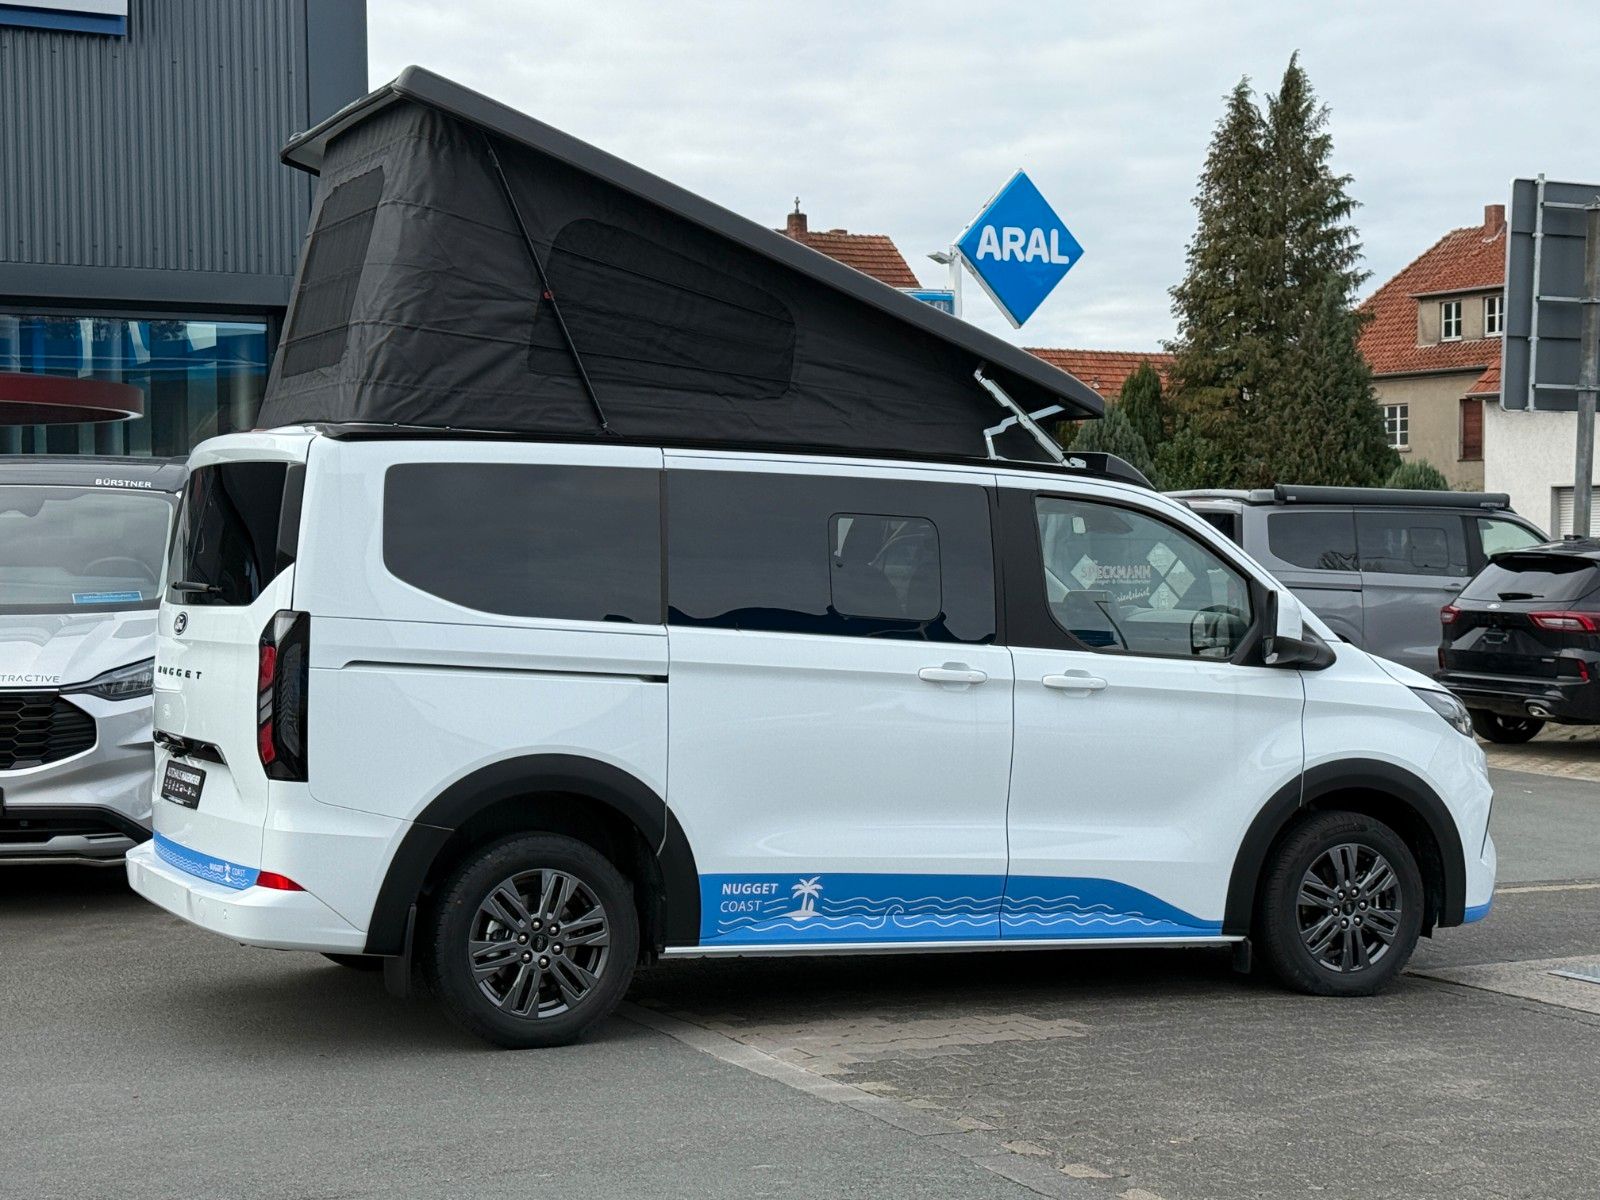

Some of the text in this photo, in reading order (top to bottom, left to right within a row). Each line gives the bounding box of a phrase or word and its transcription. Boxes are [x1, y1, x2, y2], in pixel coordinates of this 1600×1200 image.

[976, 225, 1070, 265] ARAL
[95, 478, 152, 488] BÜRSTNER
[0, 674, 60, 684] TRACTIVE
[721, 883, 780, 896] NUGGET
[720, 900, 763, 913] COAST
